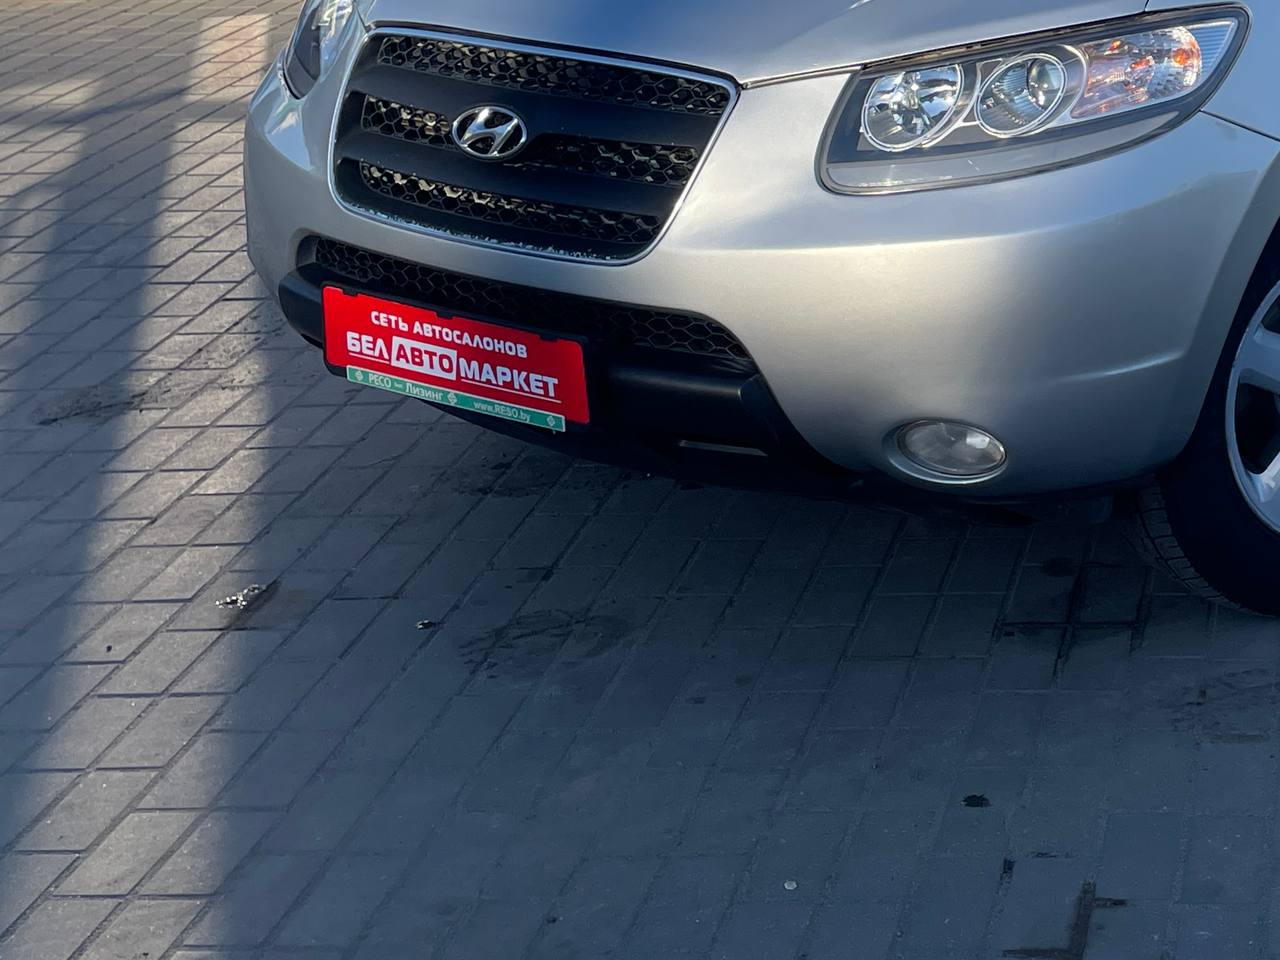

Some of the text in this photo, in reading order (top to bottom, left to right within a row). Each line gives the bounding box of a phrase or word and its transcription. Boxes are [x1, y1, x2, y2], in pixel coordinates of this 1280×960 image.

[371, 311, 528, 358] СЕТЬ АВТОСАЛОНОВ
[347, 331, 559, 399] БЕЛ АВТО МАРКЕТ
[368, 373, 392, 388] РЕСО
